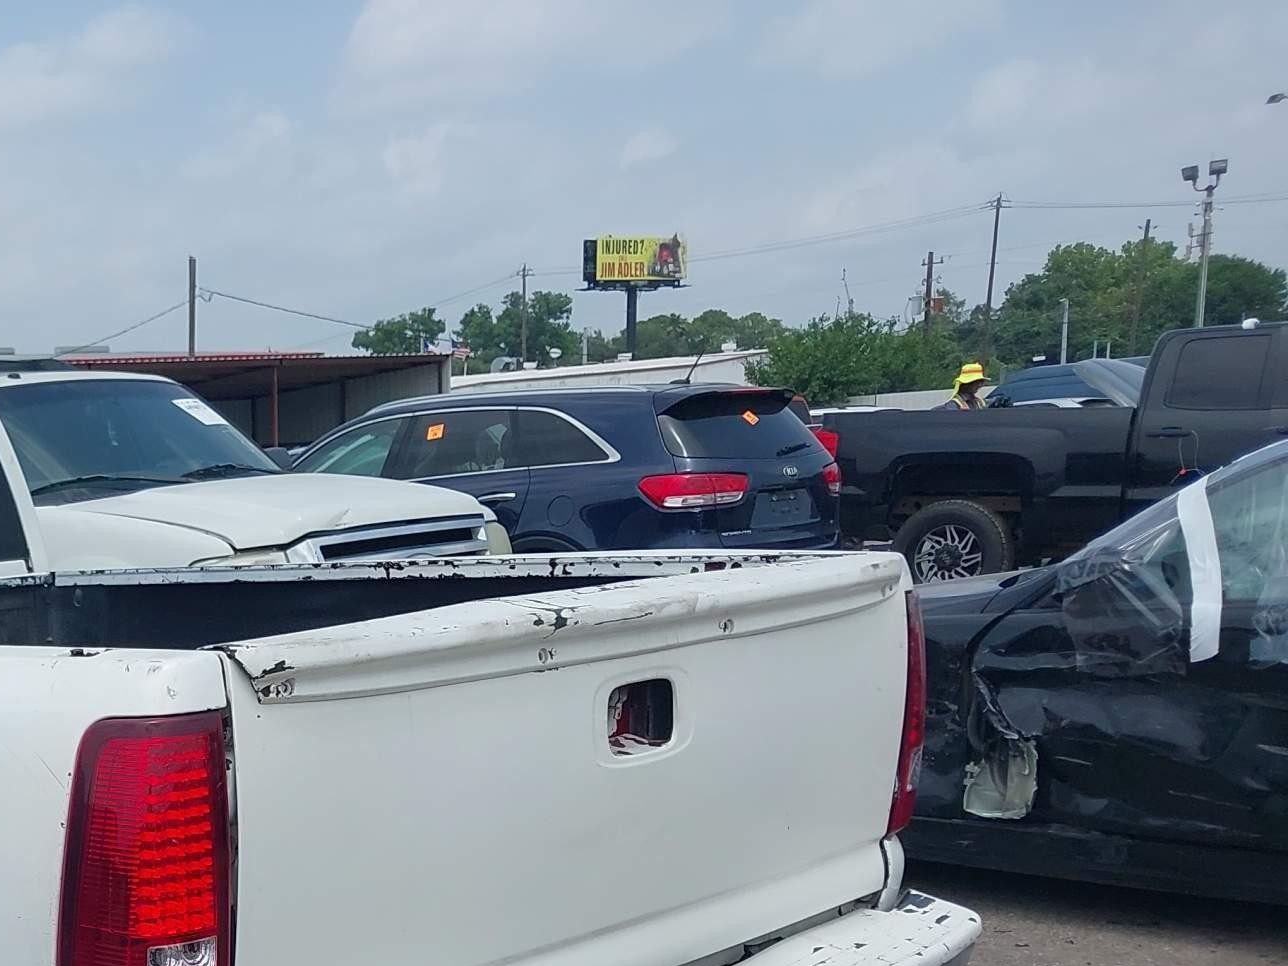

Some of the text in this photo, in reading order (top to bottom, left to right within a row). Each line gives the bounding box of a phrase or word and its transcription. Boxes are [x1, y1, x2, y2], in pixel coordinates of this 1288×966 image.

[601, 239, 645, 255] INJURED?
[600, 262, 645, 278] JIM ADLER
